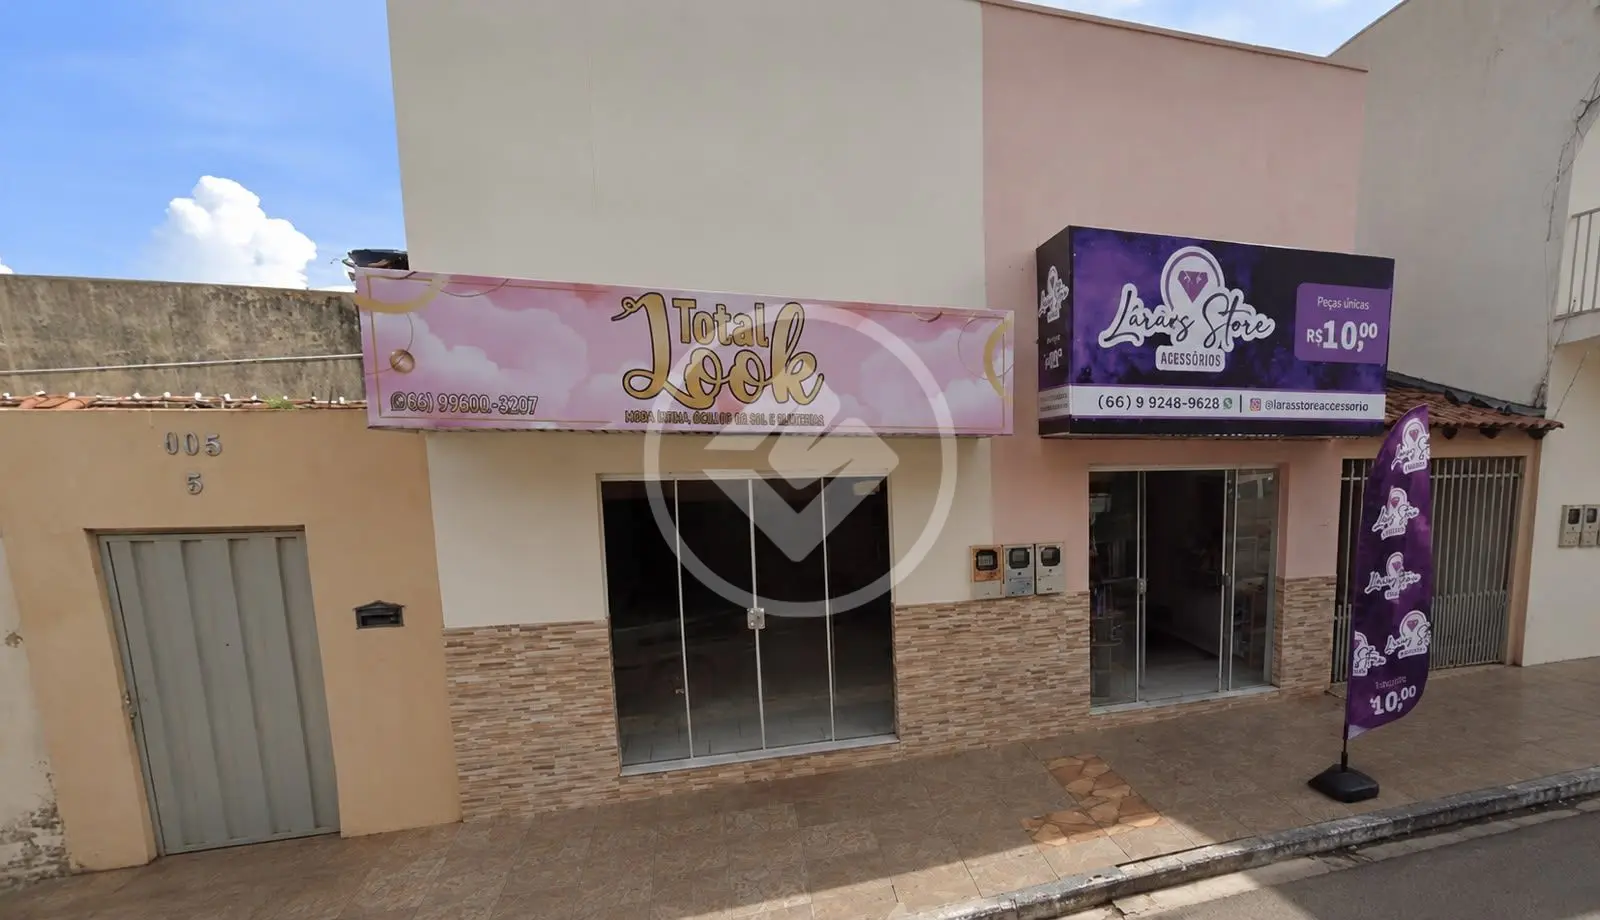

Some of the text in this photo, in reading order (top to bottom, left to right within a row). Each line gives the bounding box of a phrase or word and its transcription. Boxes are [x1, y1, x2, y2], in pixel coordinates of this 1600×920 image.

[1317, 296, 1370, 311] Peças únicas
[672, 298, 769, 347] Total
[1202, 292, 1271, 349] Store
[610, 292, 825, 410] Look
[1160, 351, 1221, 368] ACESSÓRIOS
[437, 393, 539, 415] 99600-3207
[1098, 395, 1369, 412] (66) 9 9248-9628 @larasstoreaccessorio
[164, 431, 223, 456] 005
[186, 471, 204, 495] 5
